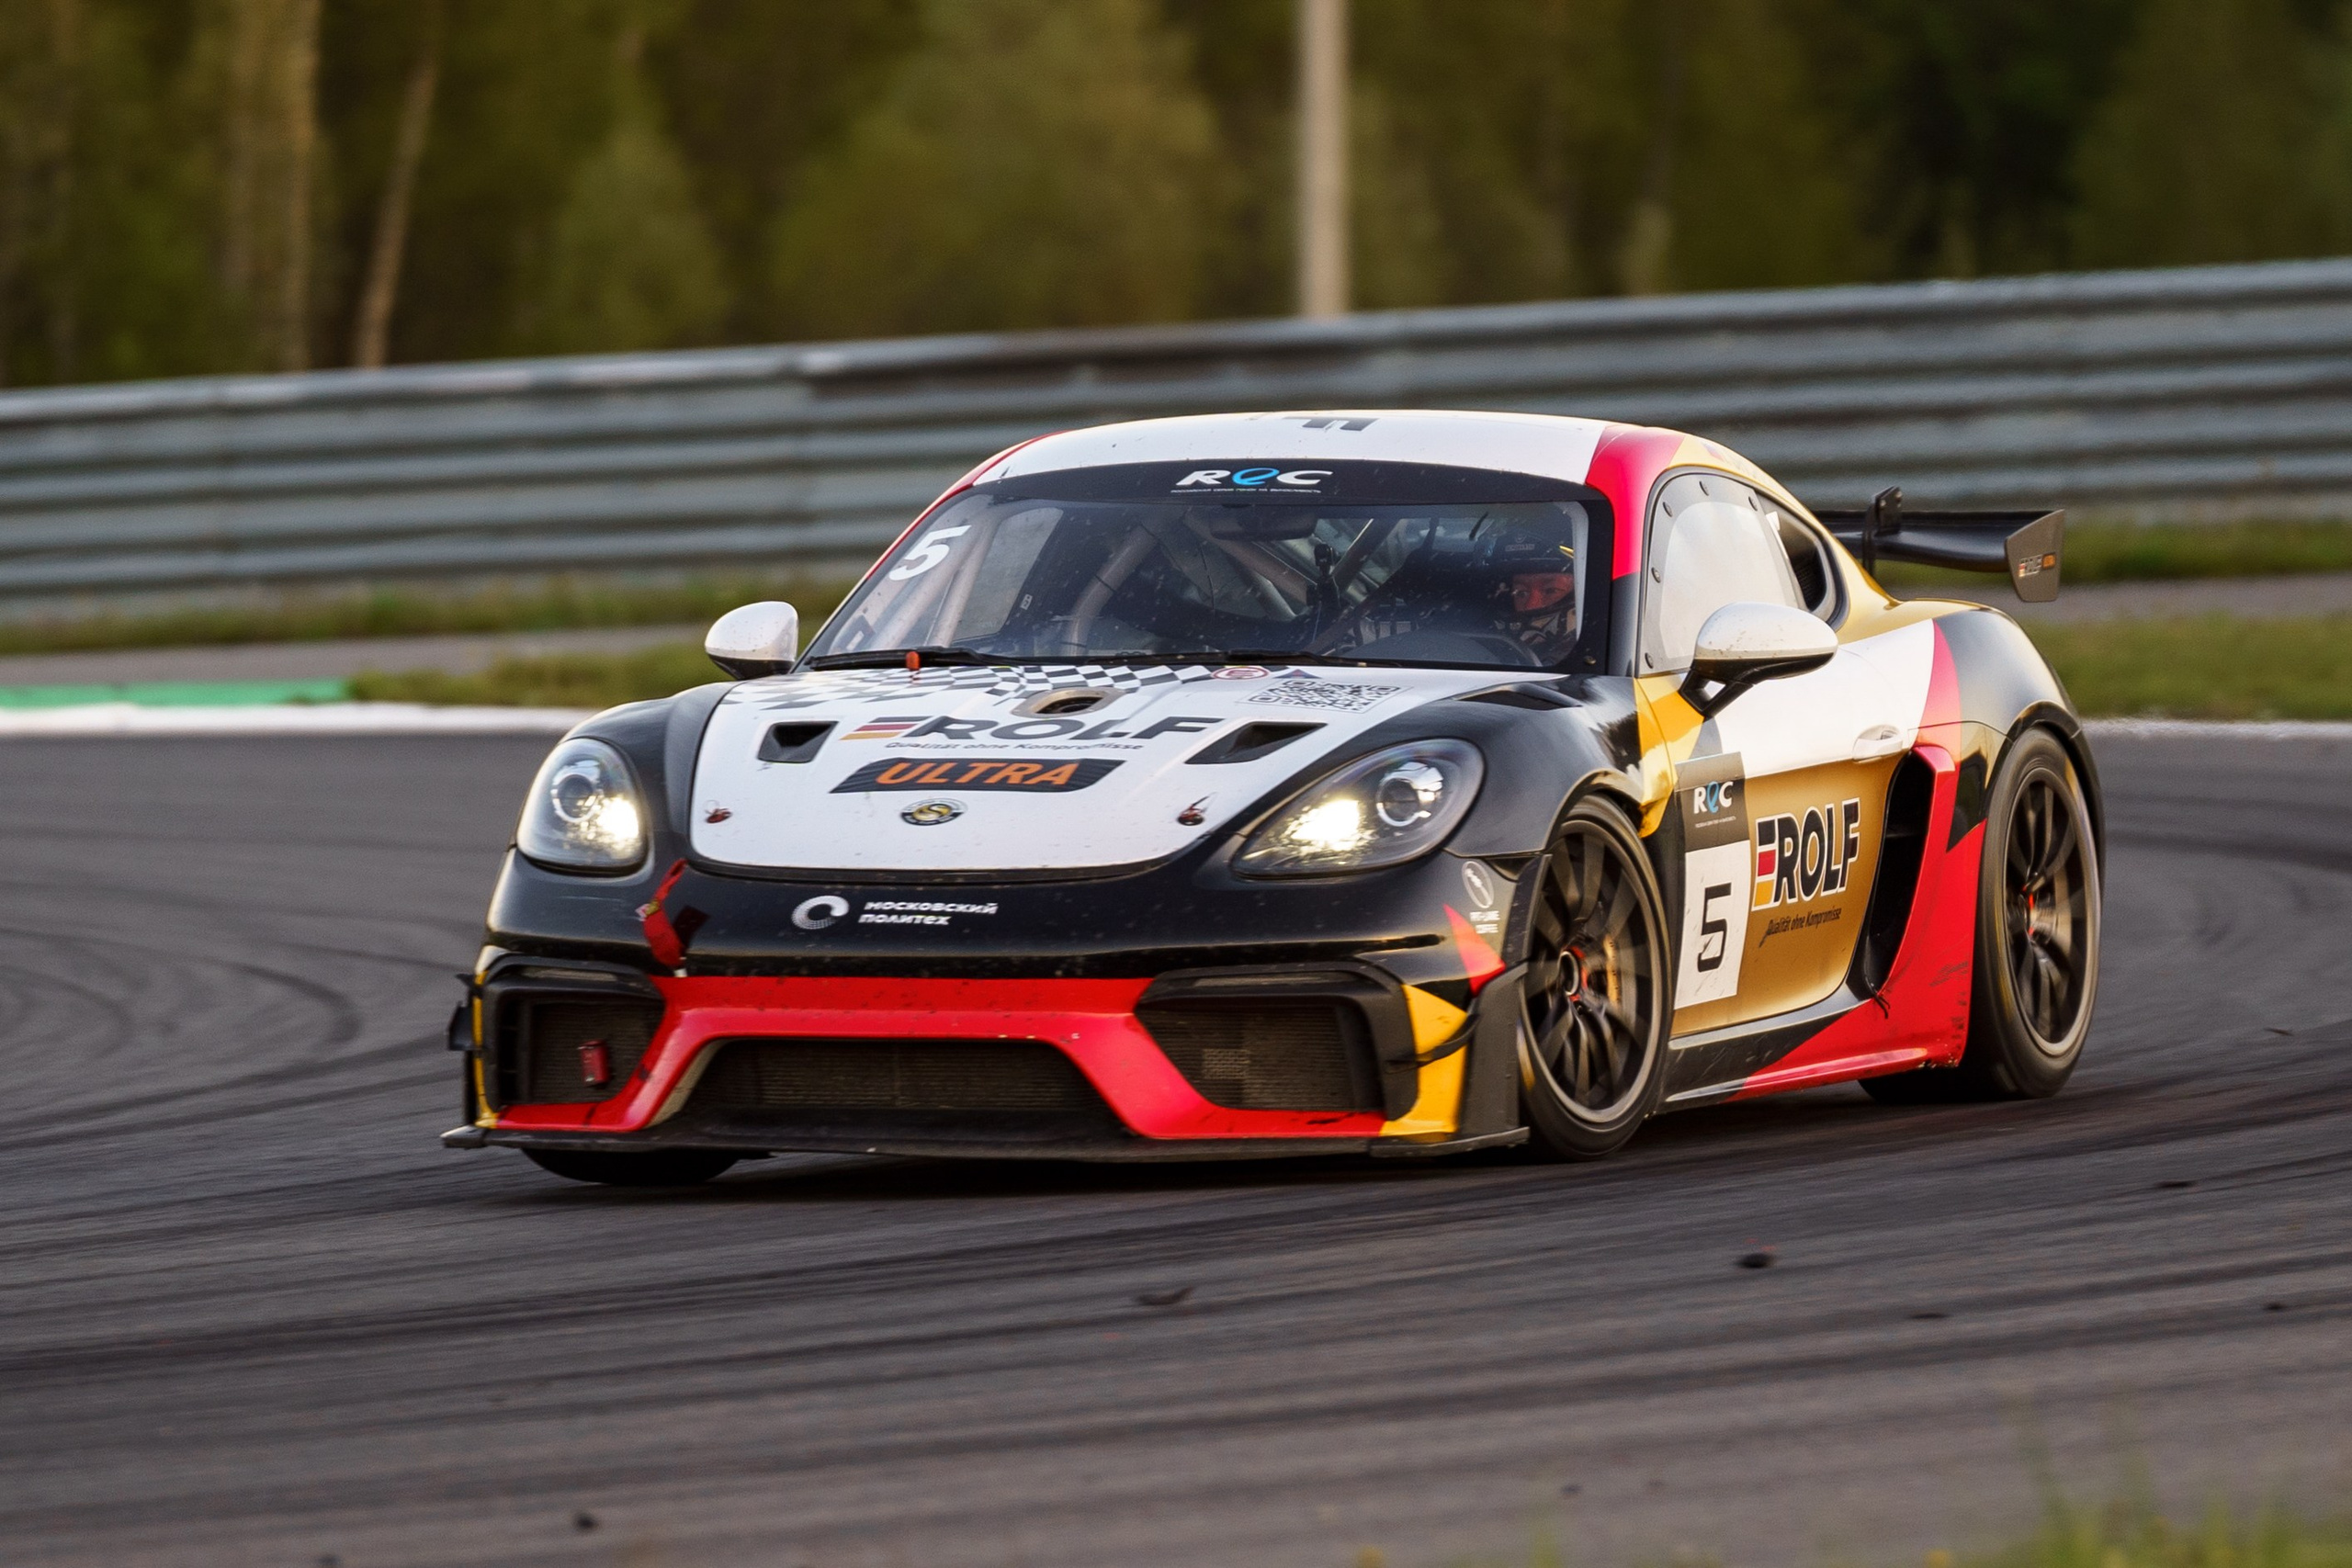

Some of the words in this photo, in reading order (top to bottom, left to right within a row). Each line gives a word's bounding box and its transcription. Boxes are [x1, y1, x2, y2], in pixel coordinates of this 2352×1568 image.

[888, 525, 972, 581] 5
[902, 716, 1226, 740] ROLF
[876, 761, 1081, 786] ULTRA
[1772, 797, 1860, 905] ROLF
[1697, 882, 1732, 973] 5
[1791, 913, 1806, 931] ohne
[1805, 905, 1842, 929] Kompromisse
